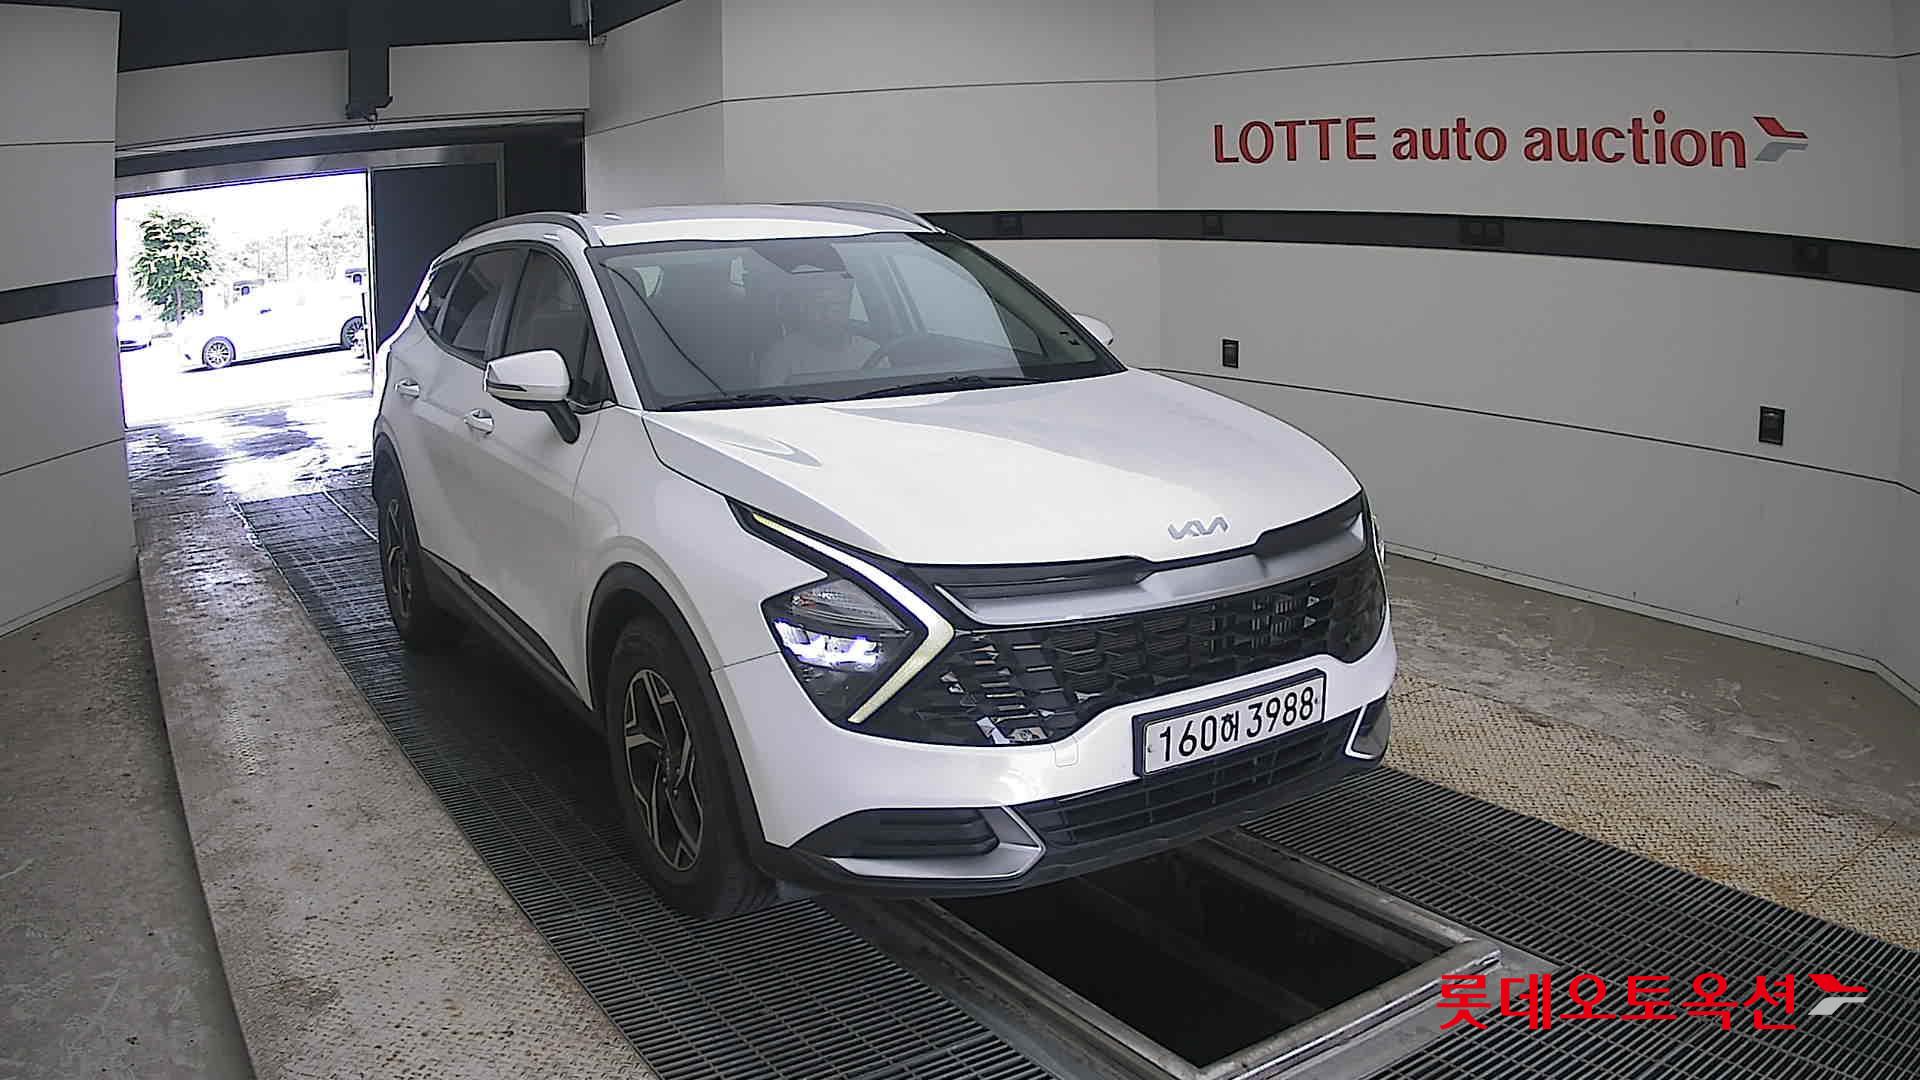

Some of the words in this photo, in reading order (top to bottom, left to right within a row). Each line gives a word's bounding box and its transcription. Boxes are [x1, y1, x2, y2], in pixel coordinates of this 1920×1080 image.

[1214, 117, 1377, 164] LOTTE
[1392, 117, 1507, 162] auto
[1524, 109, 1747, 168] auction
[1247, 686, 1314, 738] 3988
